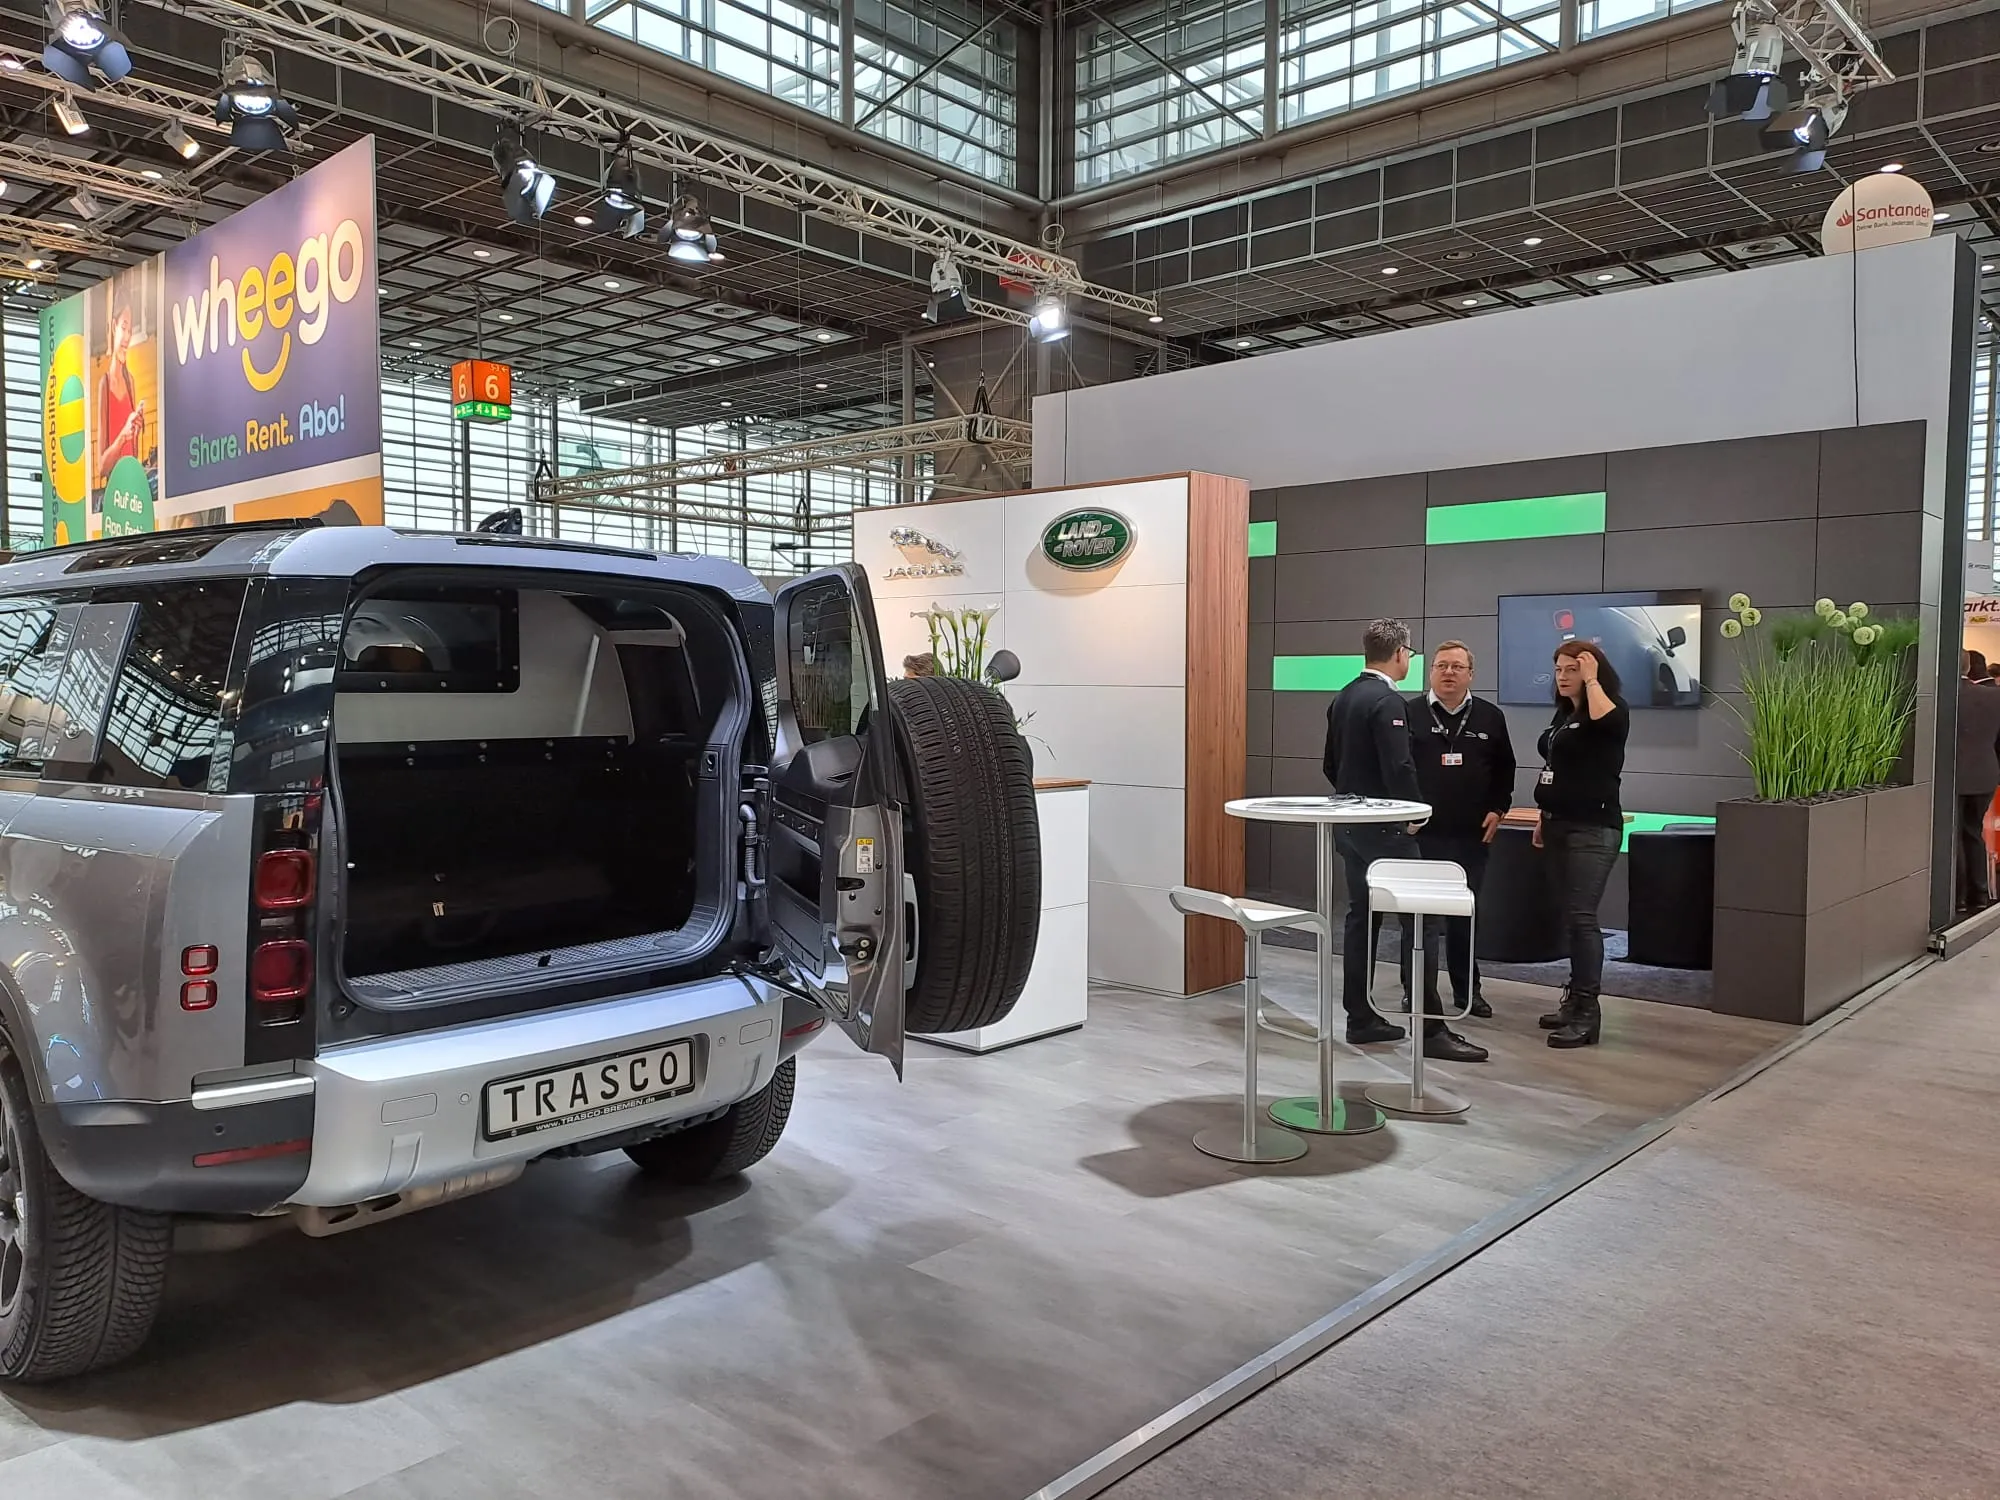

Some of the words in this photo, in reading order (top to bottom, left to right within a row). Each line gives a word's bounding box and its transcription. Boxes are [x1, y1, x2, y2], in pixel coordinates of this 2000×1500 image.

[1856, 204, 1931, 222] Santander
[173, 219, 363, 365] wheego
[459, 374, 467, 400] 6
[485, 375, 499, 400] 6
[189, 434, 241, 468] Share.
[246, 413, 294, 456] Rent.
[300, 394, 345, 441] Abo!
[113, 489, 129, 510] Auf
[129, 493, 143, 514] die
[1058, 519, 1102, 540] LAND
[1062, 537, 1115, 557] ROVER
[882, 564, 965, 579] JAGUAR
[503, 1051, 678, 1122] TRASCO
[535, 1096, 656, 1131] www.TRASCO-BREMEN.de
